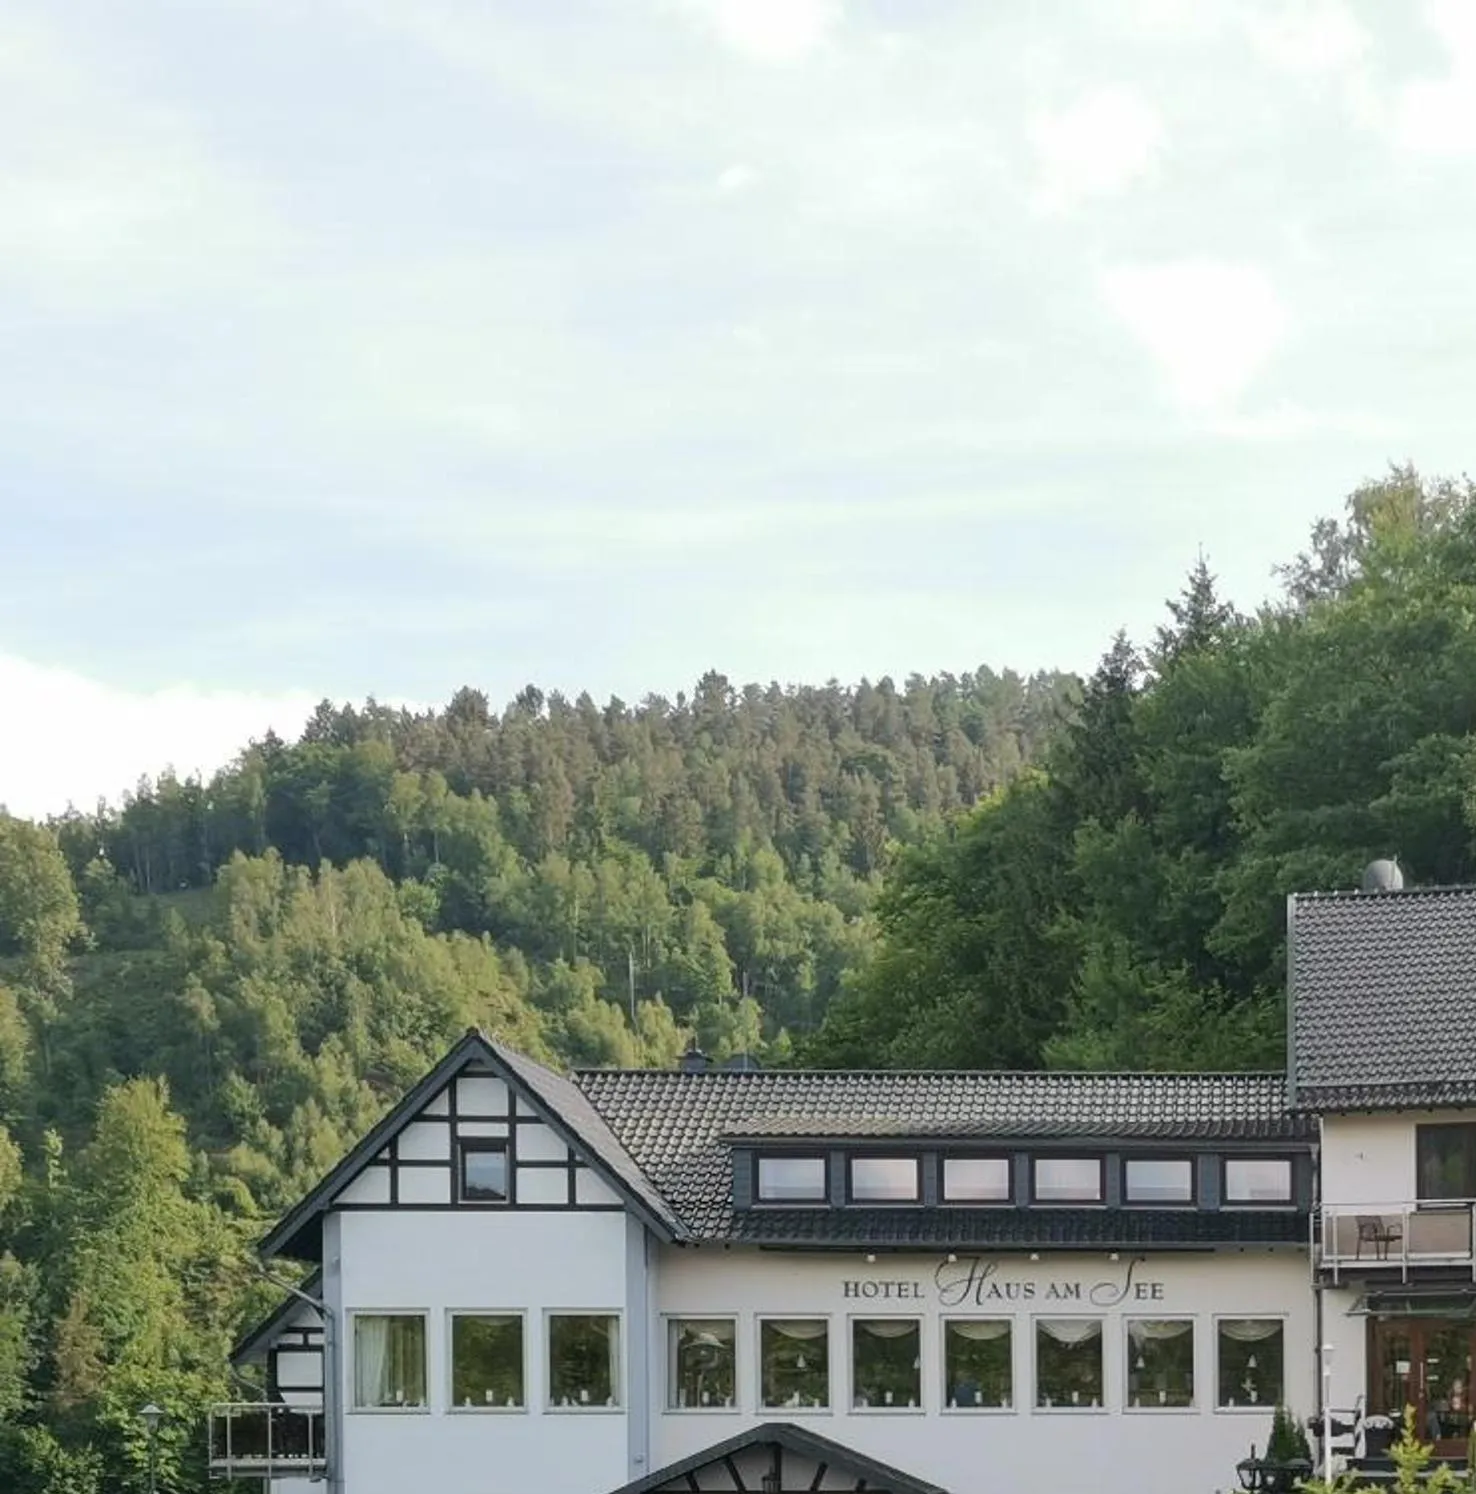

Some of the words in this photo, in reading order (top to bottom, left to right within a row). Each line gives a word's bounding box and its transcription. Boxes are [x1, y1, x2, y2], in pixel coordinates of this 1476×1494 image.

[843, 1281, 925, 1299] HOTEL
[934, 1255, 1036, 1307] HAUS
[1044, 1282, 1081, 1300] AM
[1089, 1256, 1164, 1307] SEE
